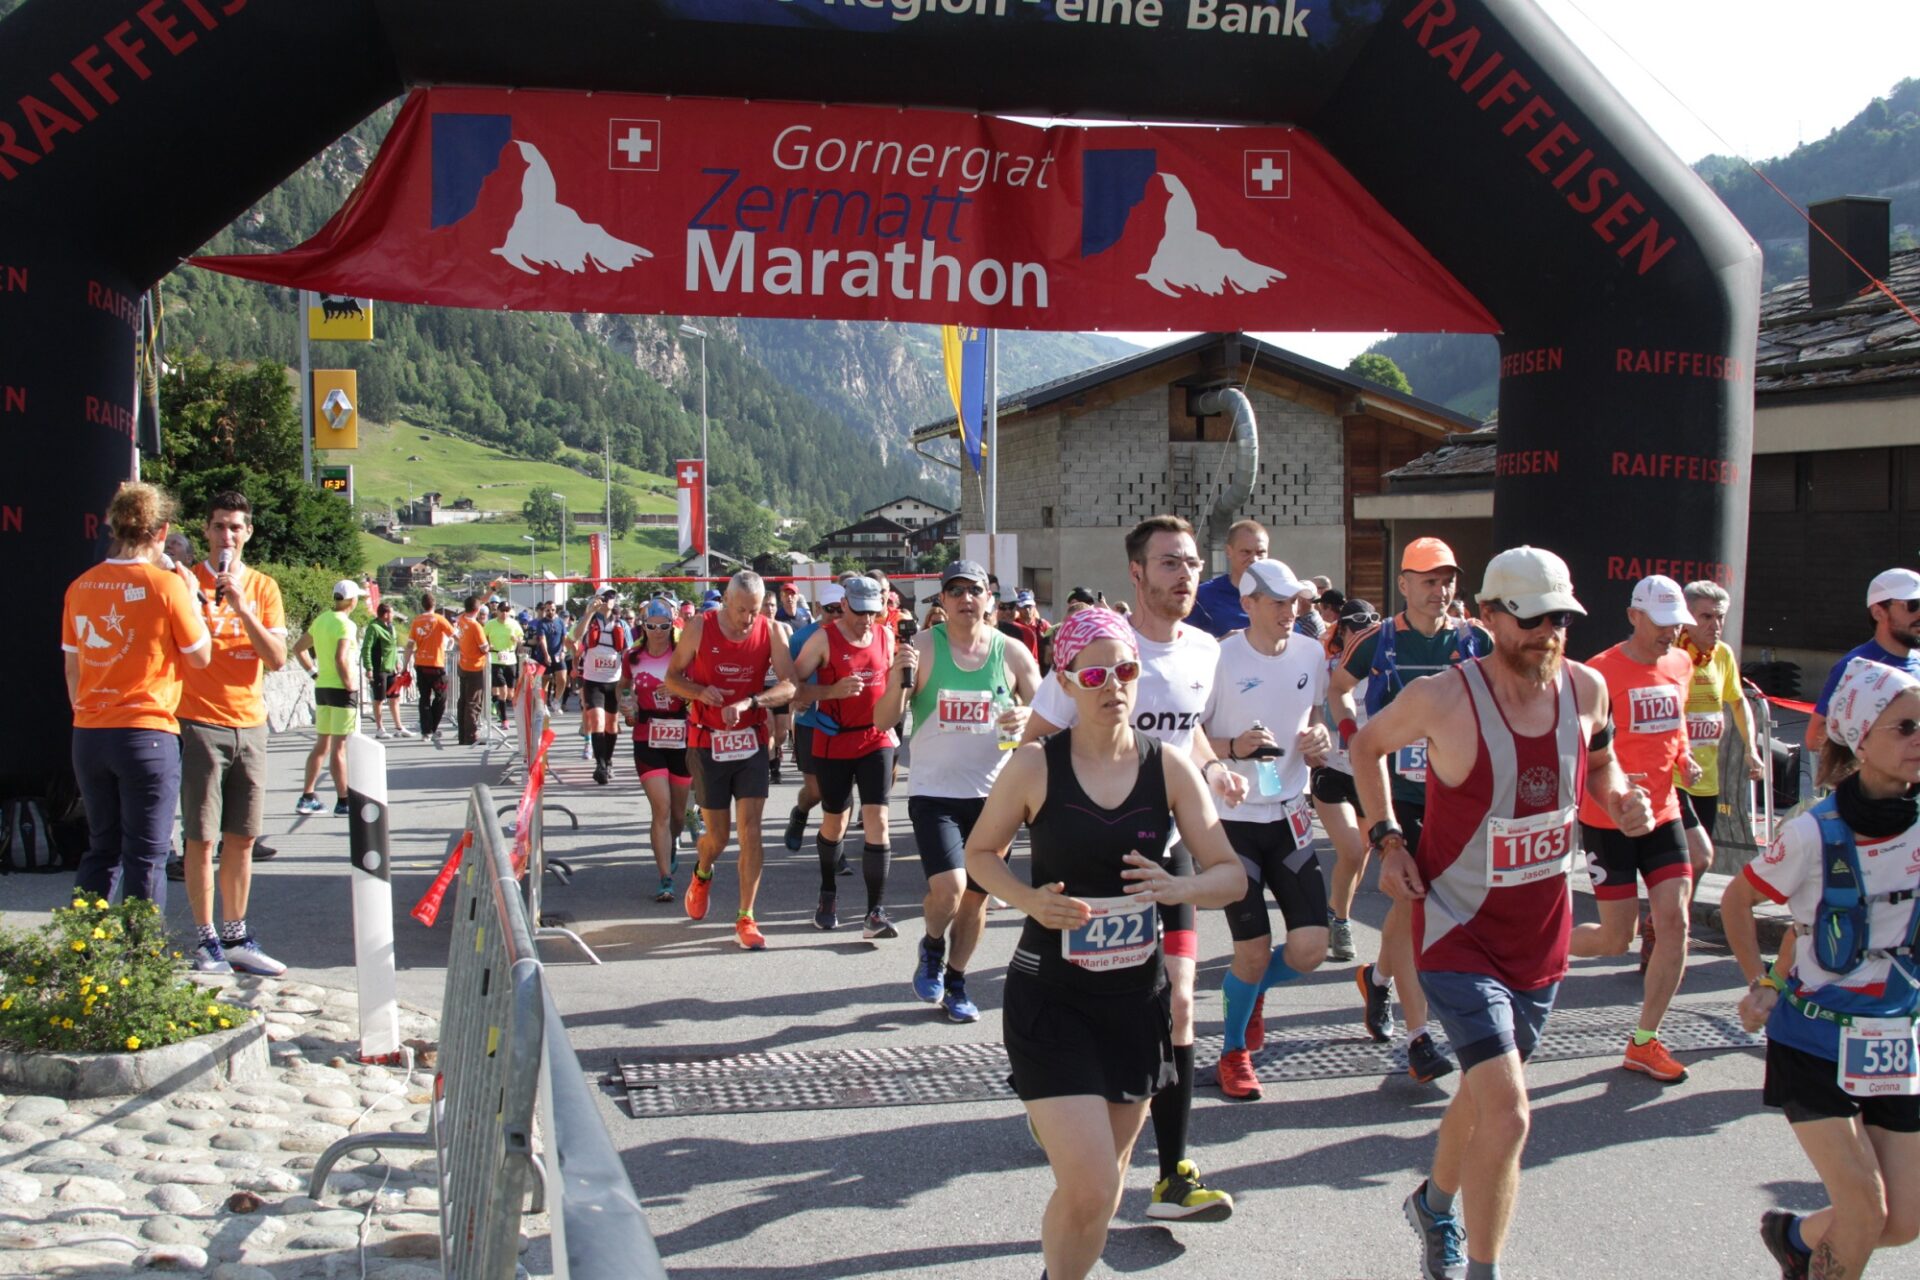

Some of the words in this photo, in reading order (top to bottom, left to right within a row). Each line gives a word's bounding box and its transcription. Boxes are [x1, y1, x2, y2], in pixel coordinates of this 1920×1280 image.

[1187, 0, 1311, 37] Bank
[0, 0, 249, 181] RAIFFEI
[1402, 0, 1677, 275] RAIFFEISEN
[773, 125, 1054, 192] Gornergrat
[687, 168, 973, 242] Zermatt
[0, 265, 28, 292] N
[685, 228, 1048, 308] Marathon
[1616, 349, 1744, 382] RAIFFEISEN
[1611, 452, 1739, 484] RAIFFEISEN
[945, 702, 985, 720] 1126
[1129, 711, 1200, 731] onz
[1640, 697, 1674, 719] 1120
[655, 727, 683, 740] 1223
[717, 736, 752, 751] 1454
[1690, 721, 1719, 738] 1109
[1504, 827, 1566, 865] 1163
[1521, 867, 1551, 881] Jason
[1085, 913, 1144, 949] 422
[1080, 955, 1110, 968] Marie
[1112, 951, 1149, 966] Pascale
[1862, 1039, 1909, 1074] 538
[1868, 1081, 1901, 1093] Corinna
